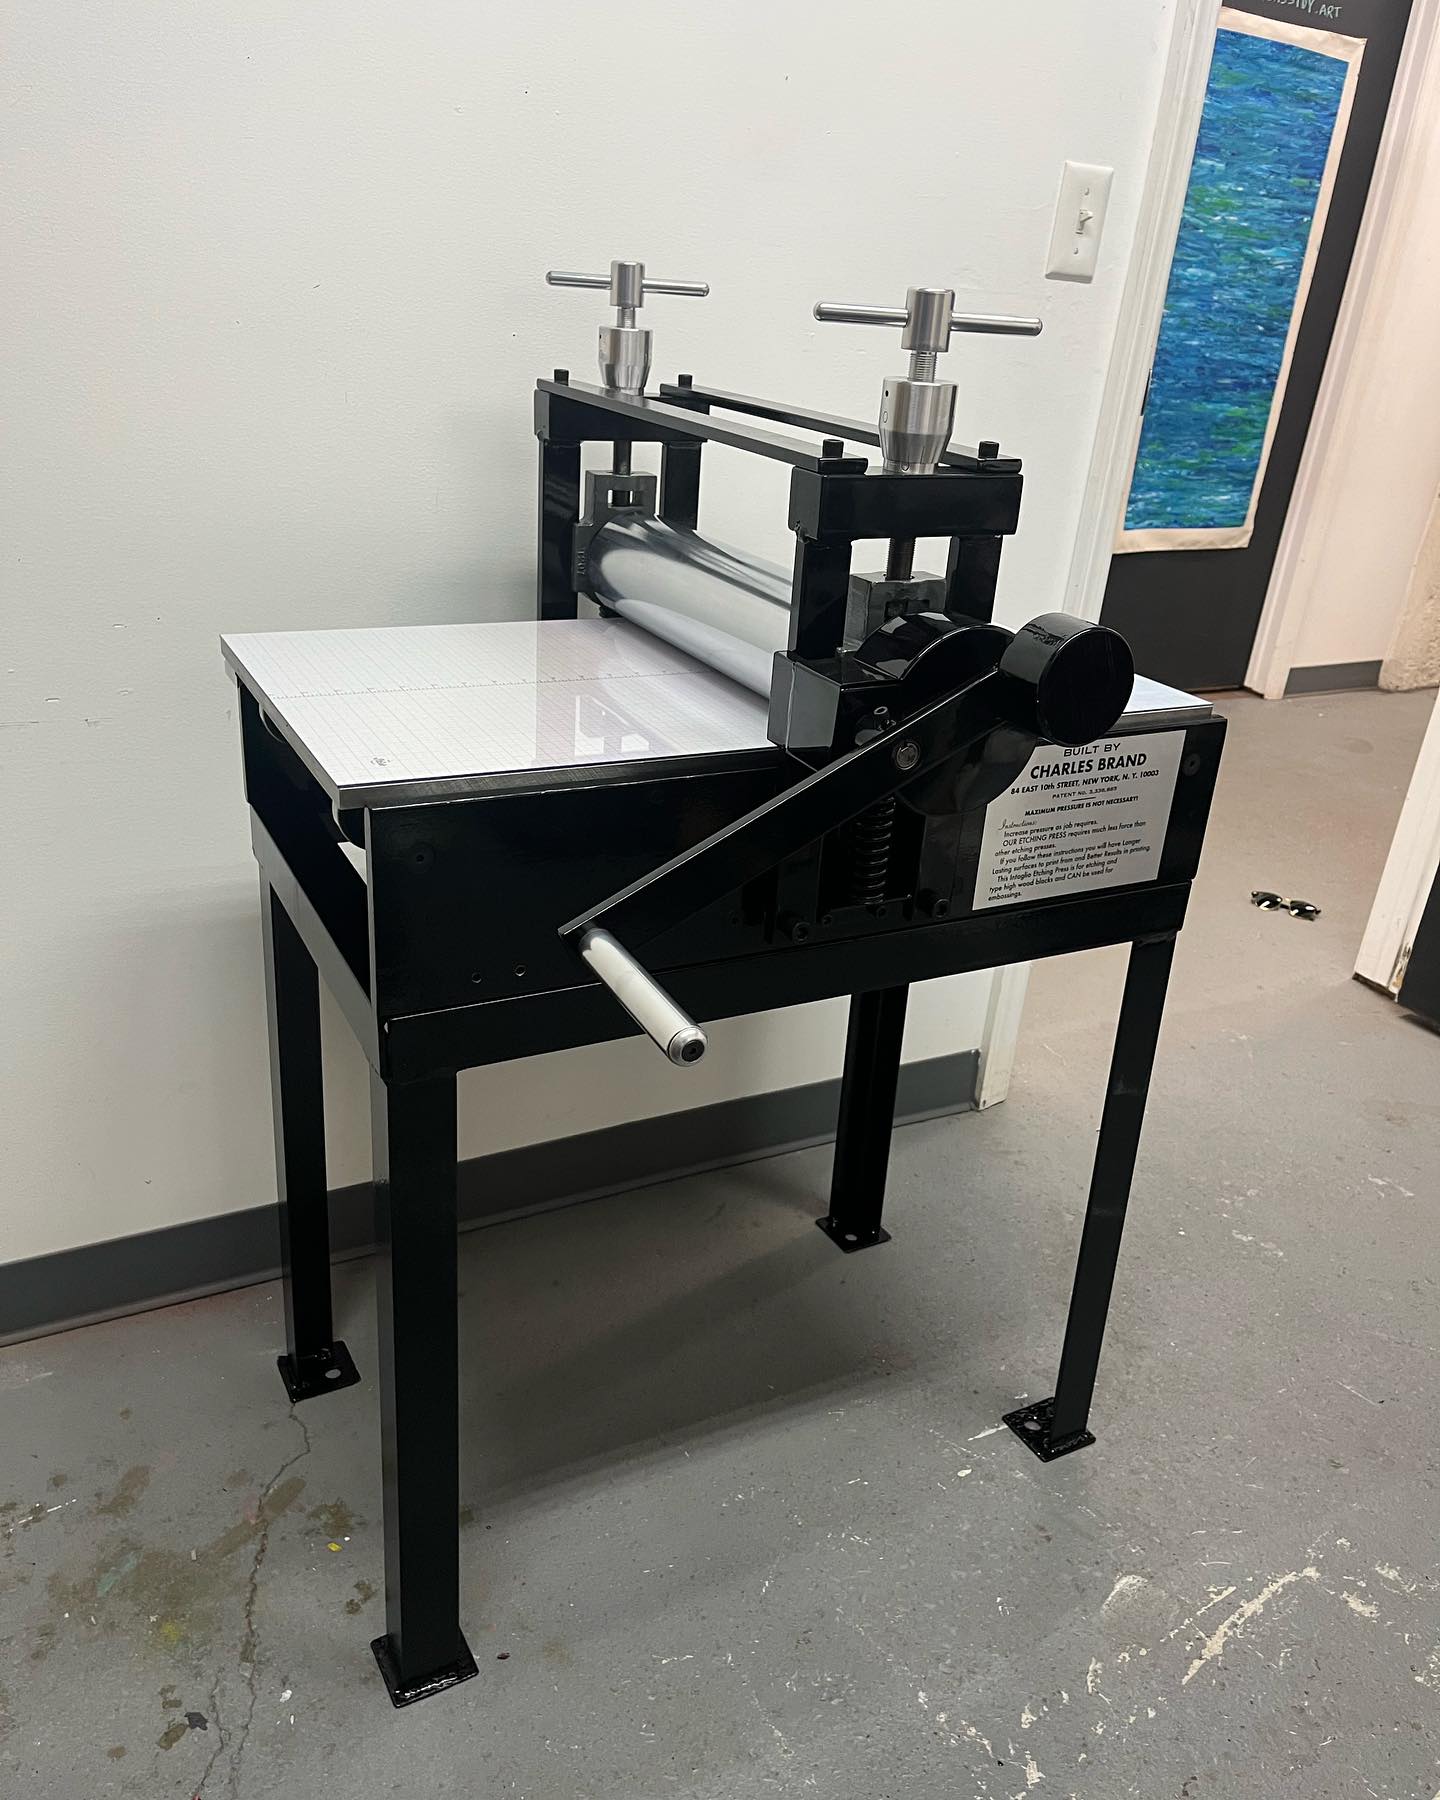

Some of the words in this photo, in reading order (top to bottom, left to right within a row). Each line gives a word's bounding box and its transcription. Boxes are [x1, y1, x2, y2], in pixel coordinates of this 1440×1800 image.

[1063, 745, 1100, 757] BUILT
[1103, 742, 1121, 752] BY
[1030, 759, 1094, 779] CHARLES
[1097, 753, 1147, 771] BRAND
[1010, 787, 1020, 795] 84
[1021, 784, 1039, 793] EAST
[1040, 782, 1055, 791] 10th
[1056, 779, 1080, 789] STREET,
[1081, 777, 1099, 786] NEW
[1140, 769, 1159, 778] 10003
[1052, 791, 1076, 799] PATENT
[1024, 807, 1056, 816] MAXIMUM
[1056, 802, 1084, 812] PRESSURE
[1002, 838, 1017, 847] OUR
[1018, 833, 1047, 845] ETCHING
[1048, 830, 1067, 840] PRESS
[1067, 829, 1090, 837] requires
[1091, 825, 1107, 834] much
[1003, 829, 1029, 837] Increase
[1029, 826, 1054, 836] pressure
[1062, 821, 1073, 831] job
[992, 867, 1012, 875] Lasting
[1013, 862, 1037, 871] surfaces
[1045, 859, 1059, 868] print
[1074, 853, 1086, 862] and
[1086, 852, 1103, 860] Better
[1103, 848, 1122, 857] Results
[994, 849, 1011, 857] other
[1011, 846, 1033, 854] etching
[999, 857, 1005, 865] If
[1004, 858, 1017, 866] you
[1017, 853, 1036, 862] follow
[1053, 847, 1084, 856] instructions
[1084, 845, 1096, 853] you
[1122, 838, 1141, 846] Longer
[989, 886, 1002, 894] type
[1003, 881, 1016, 891] high
[1017, 878, 1035, 887] wood
[1035, 876, 1053, 885] blocks
[1054, 873, 1066, 882] and
[1066, 871, 1082, 880] CAN
[1090, 867, 1104, 876] used
[1009, 871, 1032, 881] Intaglio
[1032, 868, 1054, 877] Etching
[1085, 860, 1106, 869] etching
[1106, 857, 1118, 865] and
